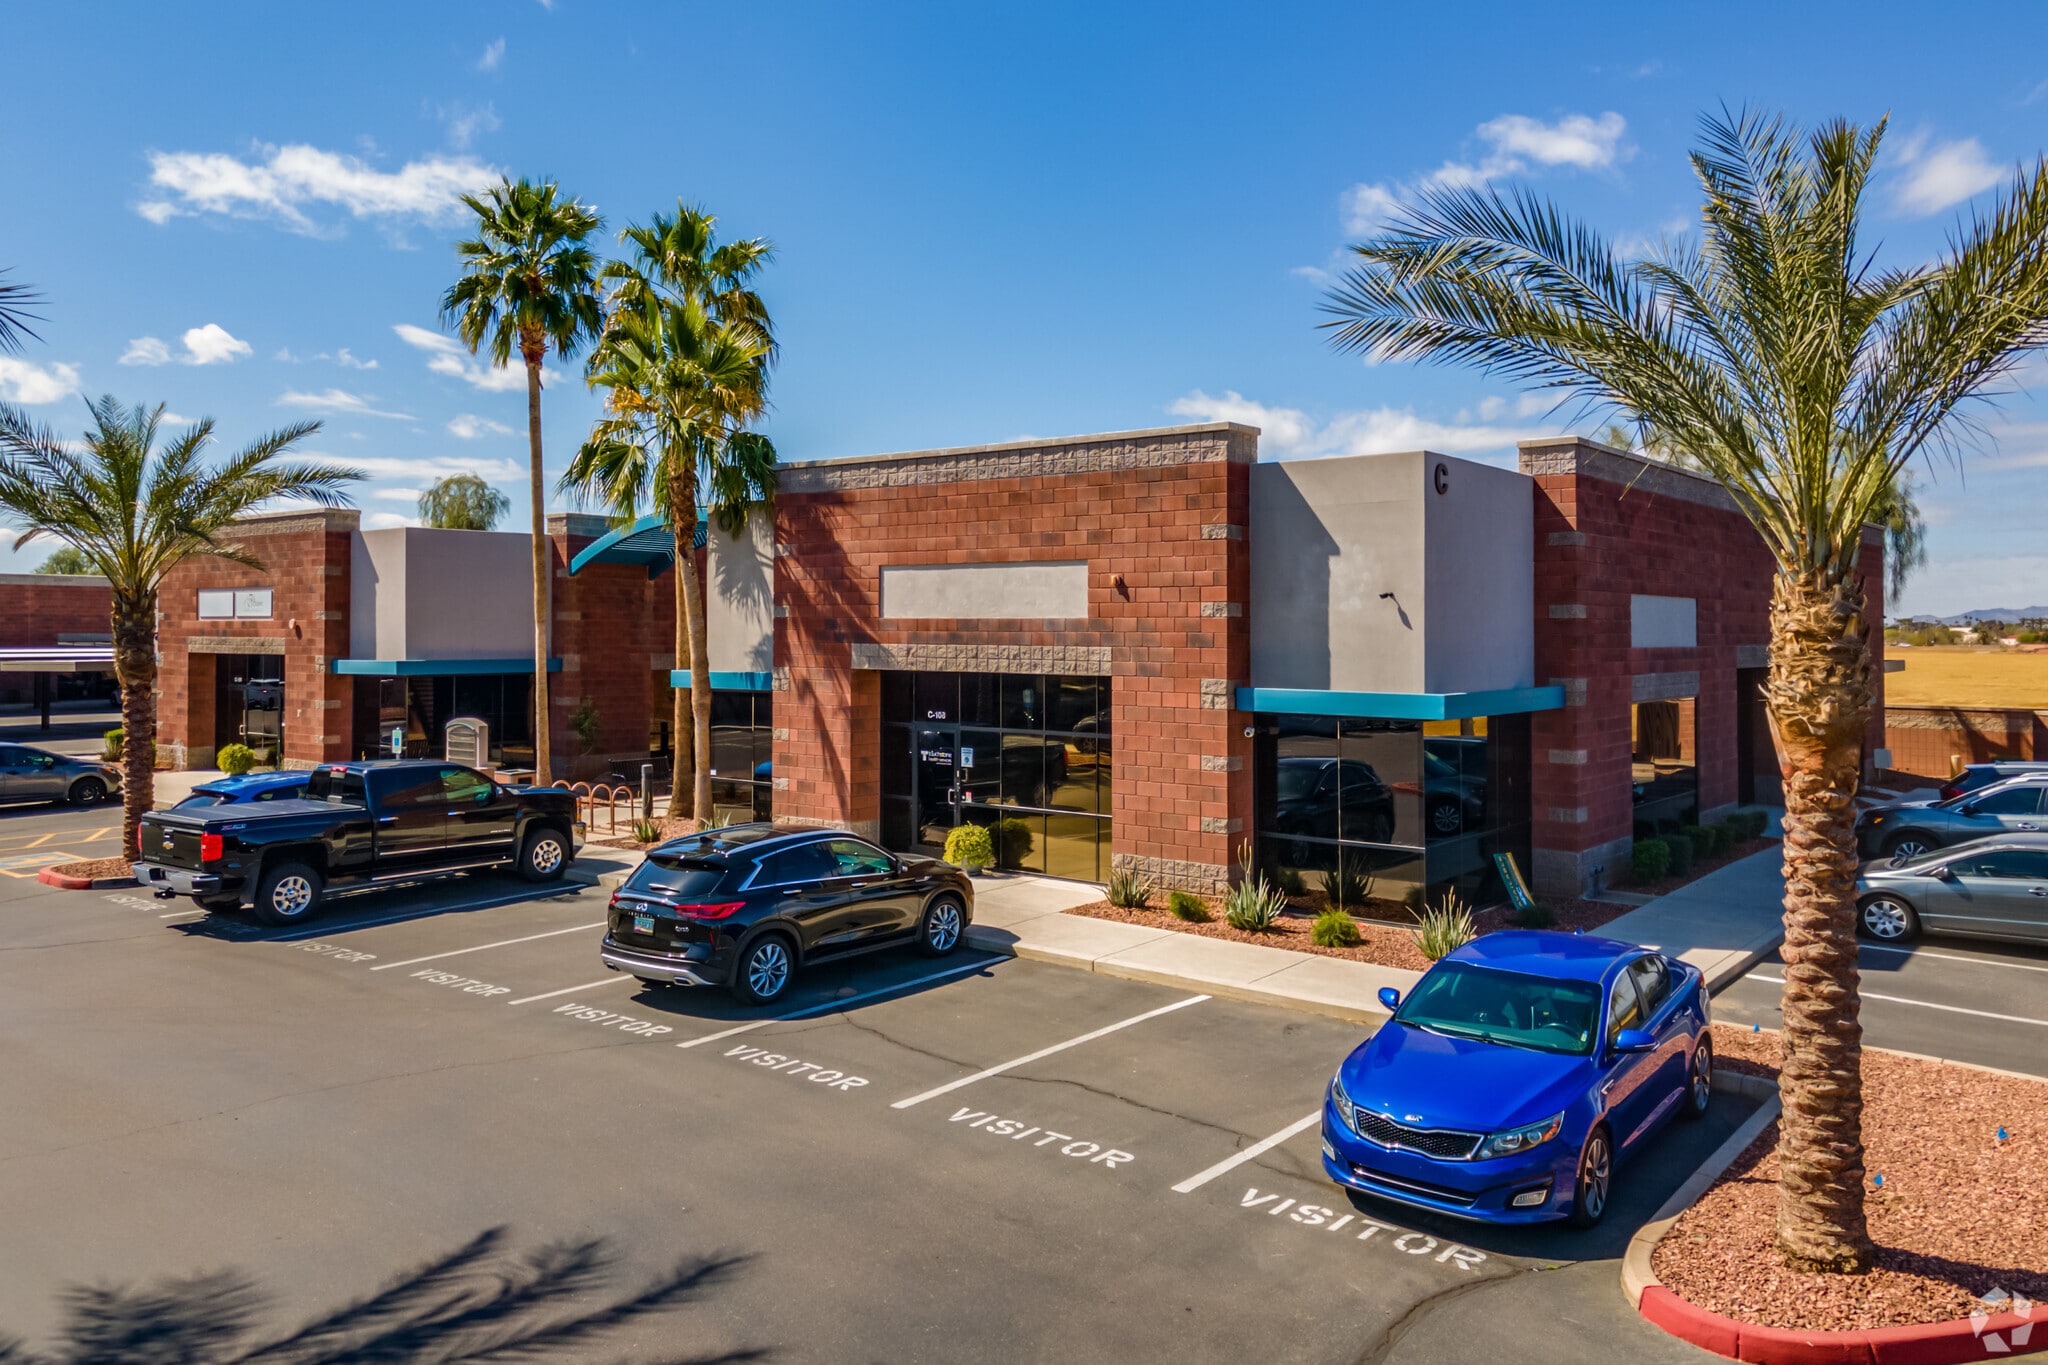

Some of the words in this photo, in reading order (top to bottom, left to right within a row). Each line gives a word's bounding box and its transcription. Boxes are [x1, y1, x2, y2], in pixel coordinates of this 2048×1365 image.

[1434, 463, 1449, 496] C
[409, 968, 511, 997] VISITOR
[552, 1003, 673, 1037] VISITOR
[723, 1045, 870, 1091] VISITOR
[948, 1107, 1135, 1169] VISITOR
[1240, 1188, 1488, 1271] VISITOR
